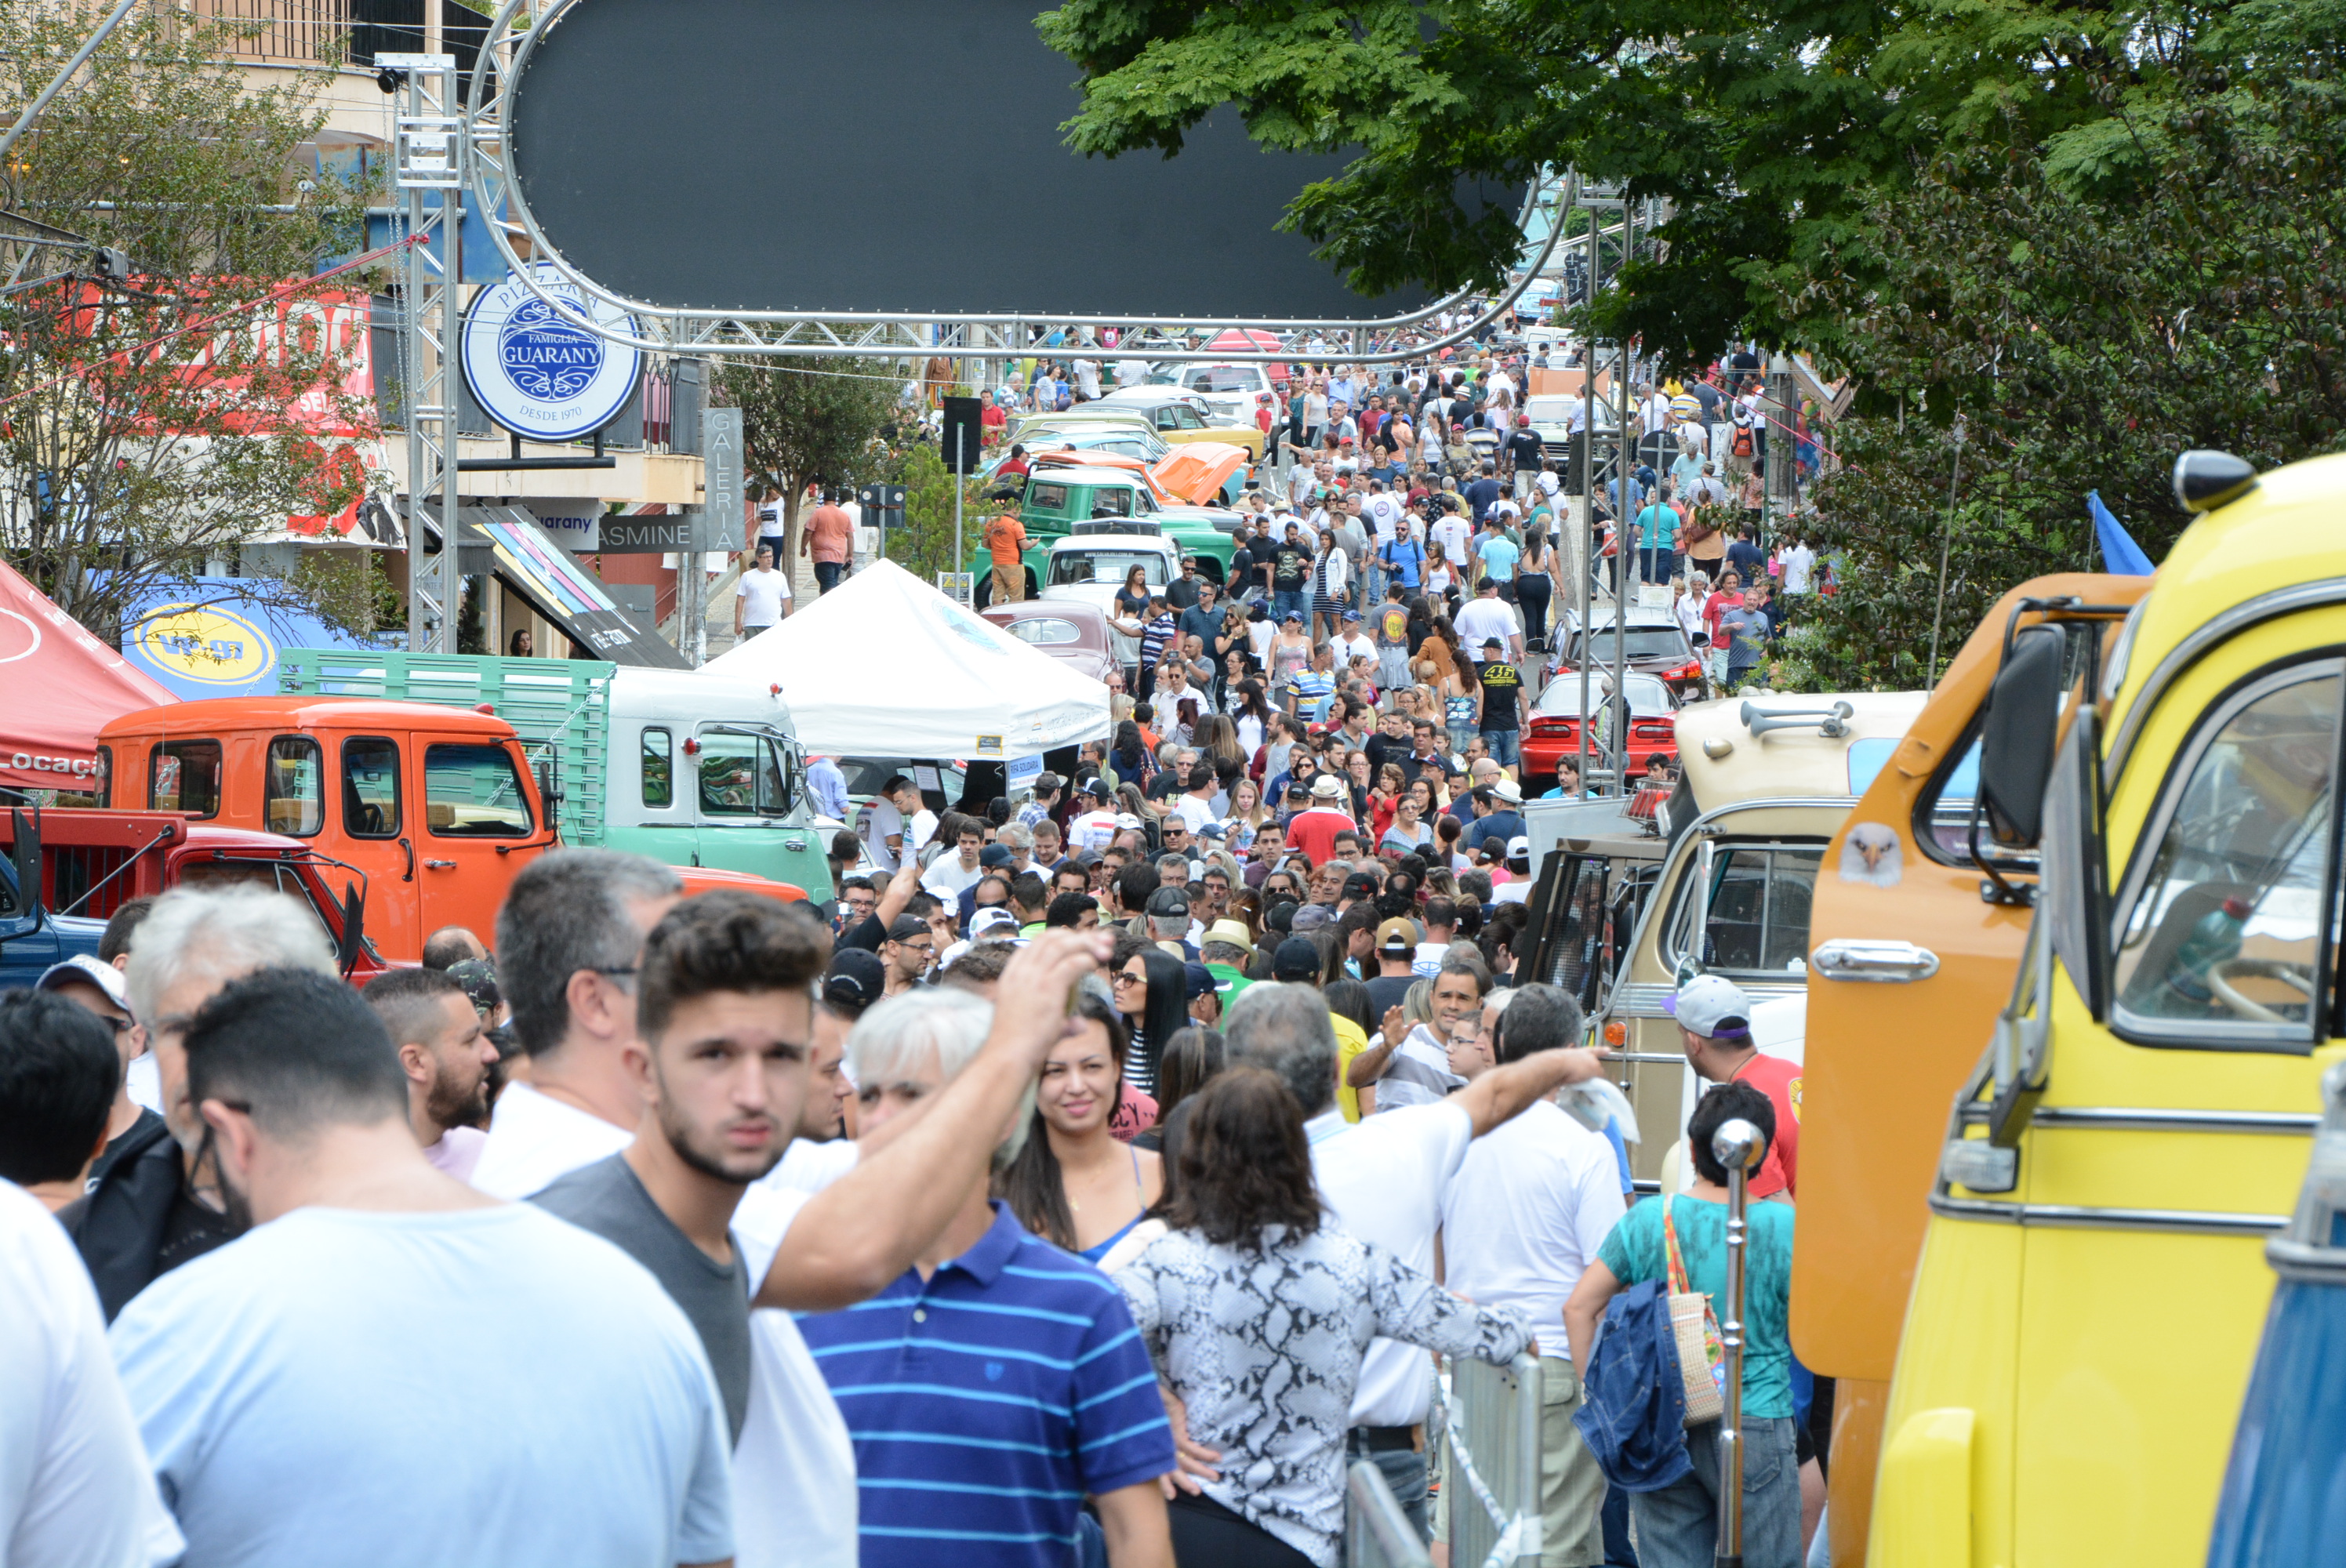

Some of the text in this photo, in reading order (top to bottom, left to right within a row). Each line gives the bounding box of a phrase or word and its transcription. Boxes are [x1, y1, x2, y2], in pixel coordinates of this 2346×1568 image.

[528, 334, 579, 343] FAMIGLIA
[503, 347, 601, 364] GUARANY
[519, 405, 583, 421] DESDE 1970
[711, 412, 735, 550] GALERIA
[534, 514, 592, 534] uarany
[1484, 665, 1516, 679] 46
